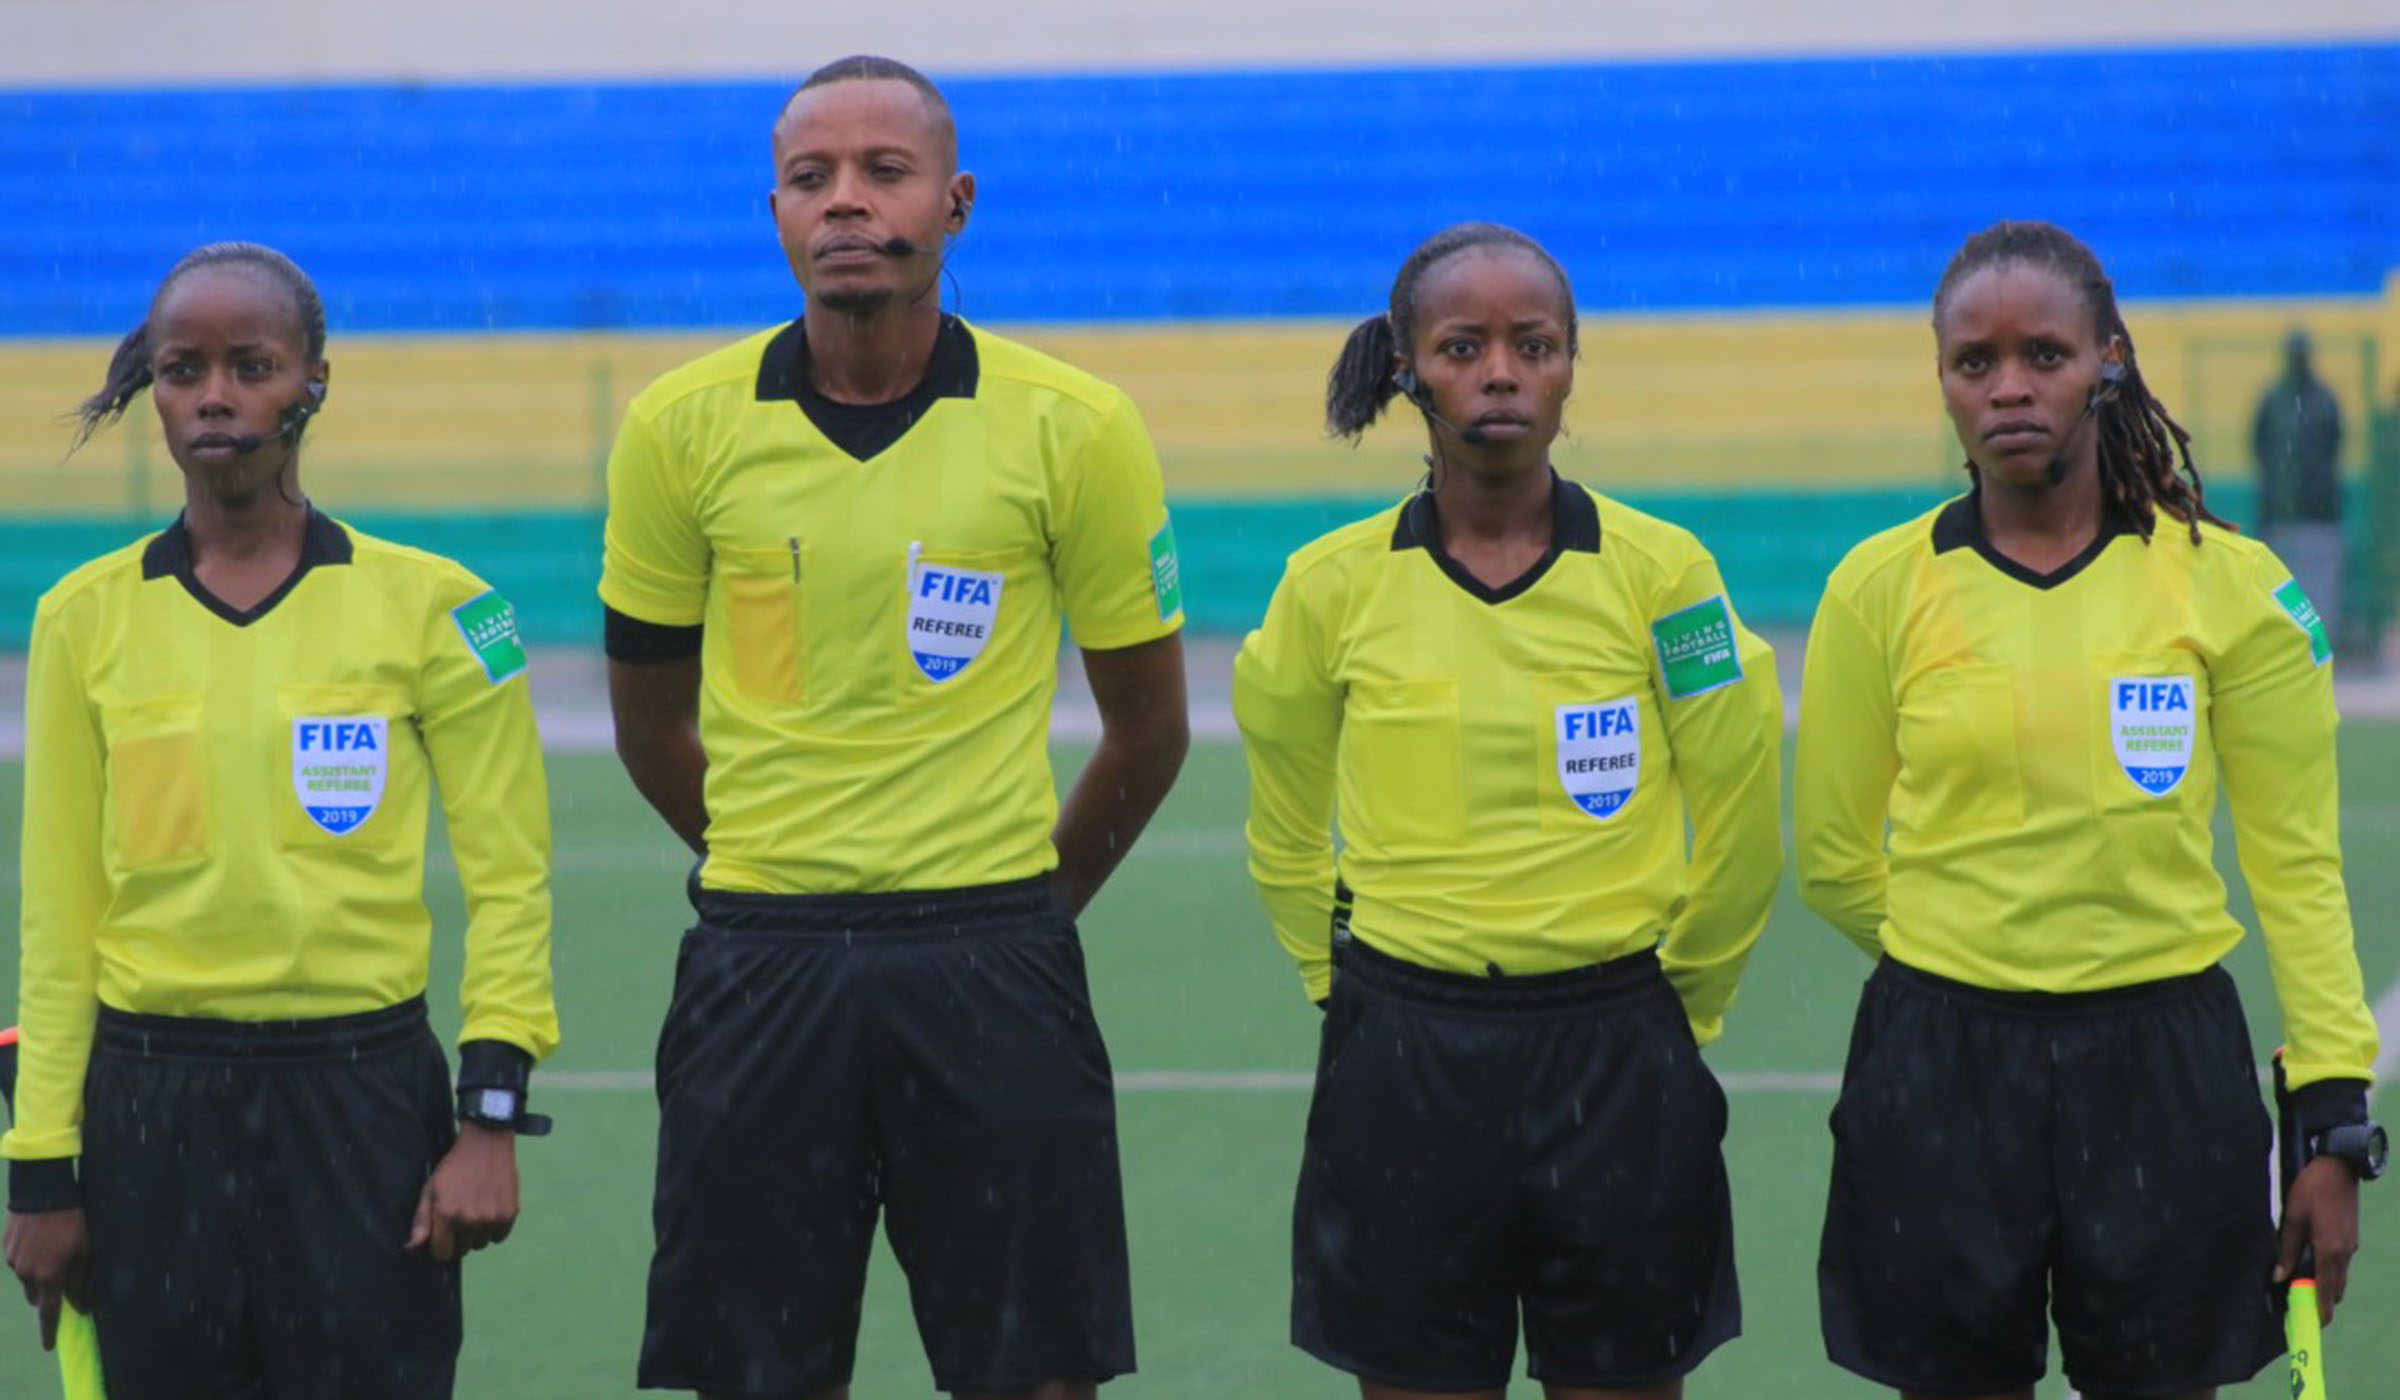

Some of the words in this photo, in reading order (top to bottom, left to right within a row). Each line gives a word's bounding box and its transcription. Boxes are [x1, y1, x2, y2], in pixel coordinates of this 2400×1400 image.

[921, 570, 991, 605] FIFA
[912, 616, 986, 639] REFEREE
[1663, 619, 1726, 650] LIVING
[924, 657, 958, 674] 2019
[2118, 683, 2188, 711] FIFA
[1564, 706, 1634, 741] FIFA
[2121, 725, 2189, 737] ASSISTANT
[300, 723, 377, 751] FIFA
[2125, 739, 2184, 752] REFEREE
[302, 765, 378, 777] ASSISTANT
[1565, 752, 1636, 775] REFEREE
[307, 779, 372, 791] REFEREE
[2140, 769, 2175, 785] 2019
[1588, 793, 1622, 810] 2019
[321, 809, 357, 824] 2019
